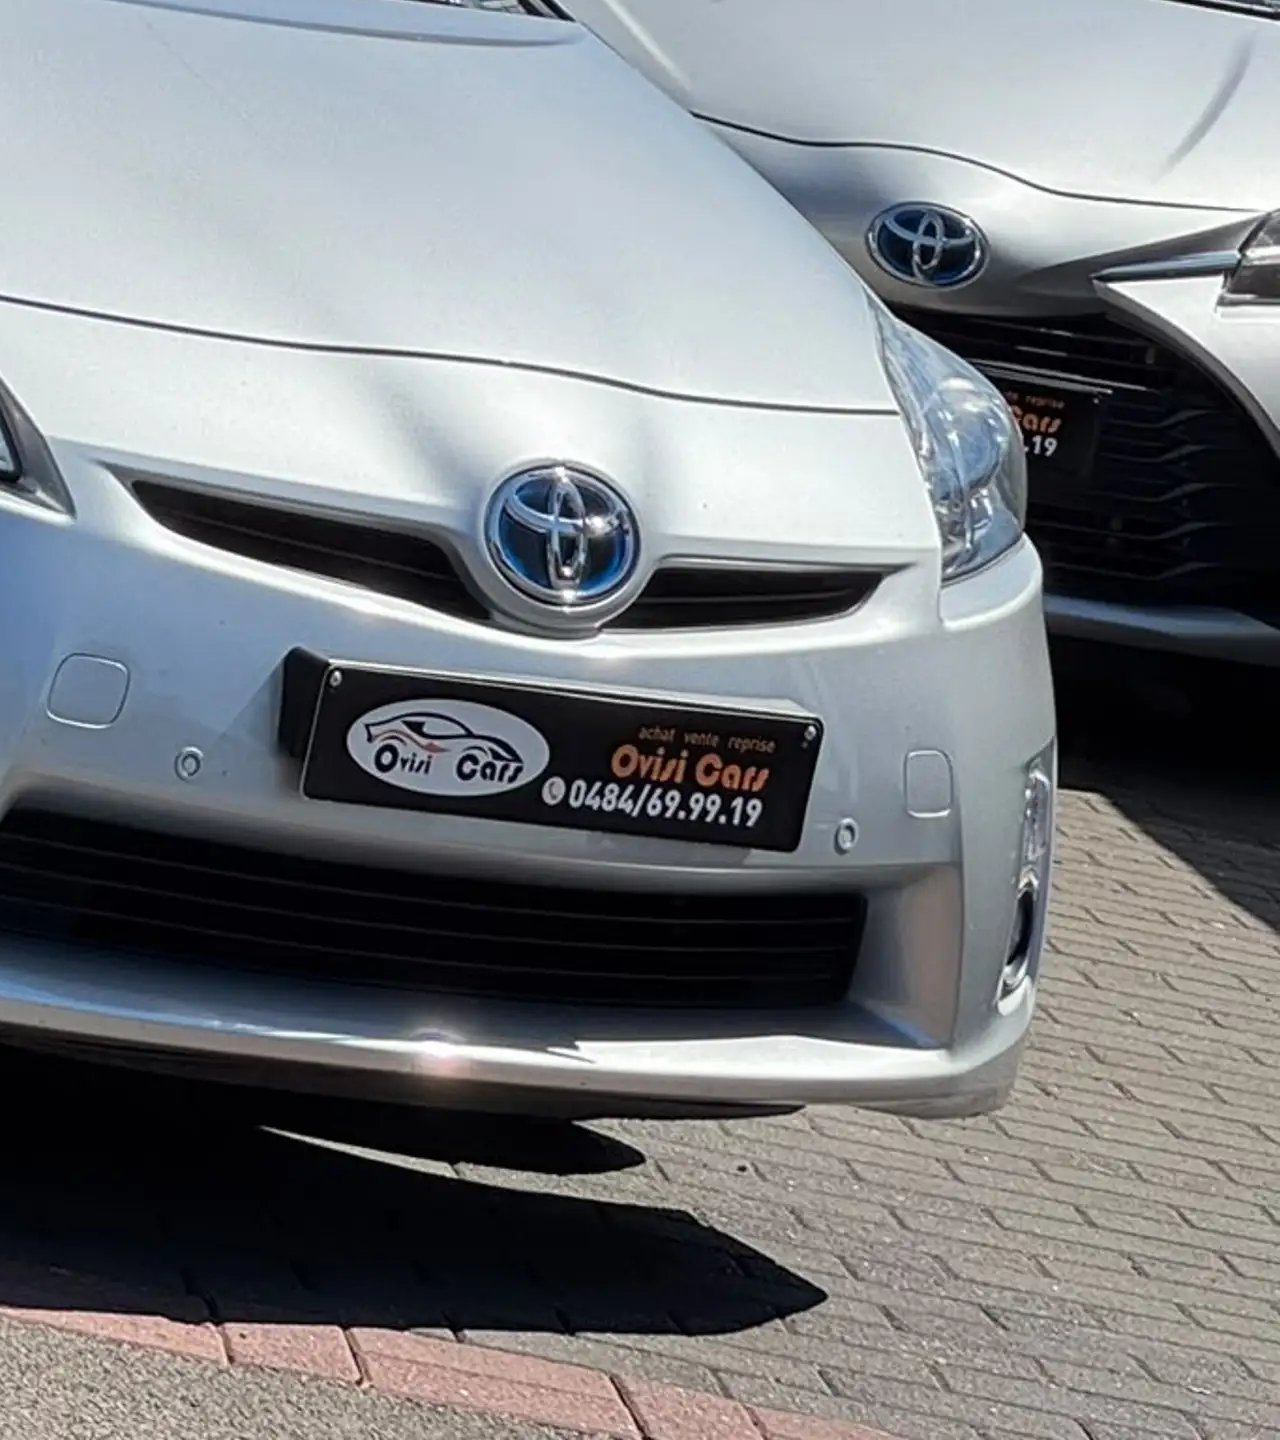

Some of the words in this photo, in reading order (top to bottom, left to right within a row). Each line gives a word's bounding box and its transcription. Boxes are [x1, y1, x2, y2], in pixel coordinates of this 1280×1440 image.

[638, 725, 676, 743] achat
[684, 731, 720, 748] vente
[727, 736, 776, 754] reprise
[374, 744, 432, 774] Ovisi
[456, 754, 523, 784] Cars
[611, 744, 689, 783] Ovisi
[695, 753, 770, 792] Cars
[569, 778, 763, 828] 0484/69.99.19
